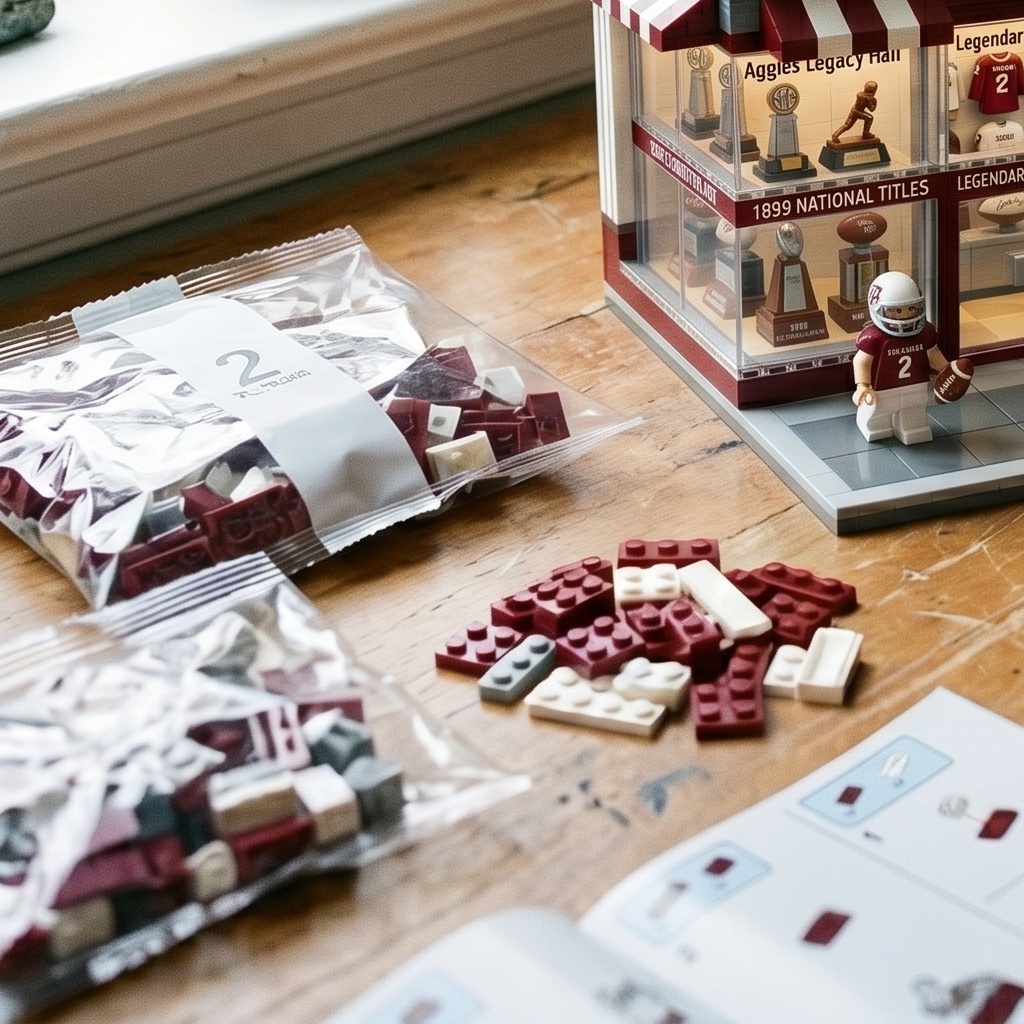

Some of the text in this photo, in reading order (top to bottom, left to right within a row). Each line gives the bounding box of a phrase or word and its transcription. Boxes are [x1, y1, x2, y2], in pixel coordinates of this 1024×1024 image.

[995, 73, 1010, 94] 2
[752, 179, 930, 221] 1899 NATIONAL TITLES
[216, 348, 282, 388] 2
[898, 355, 912, 380] 2
